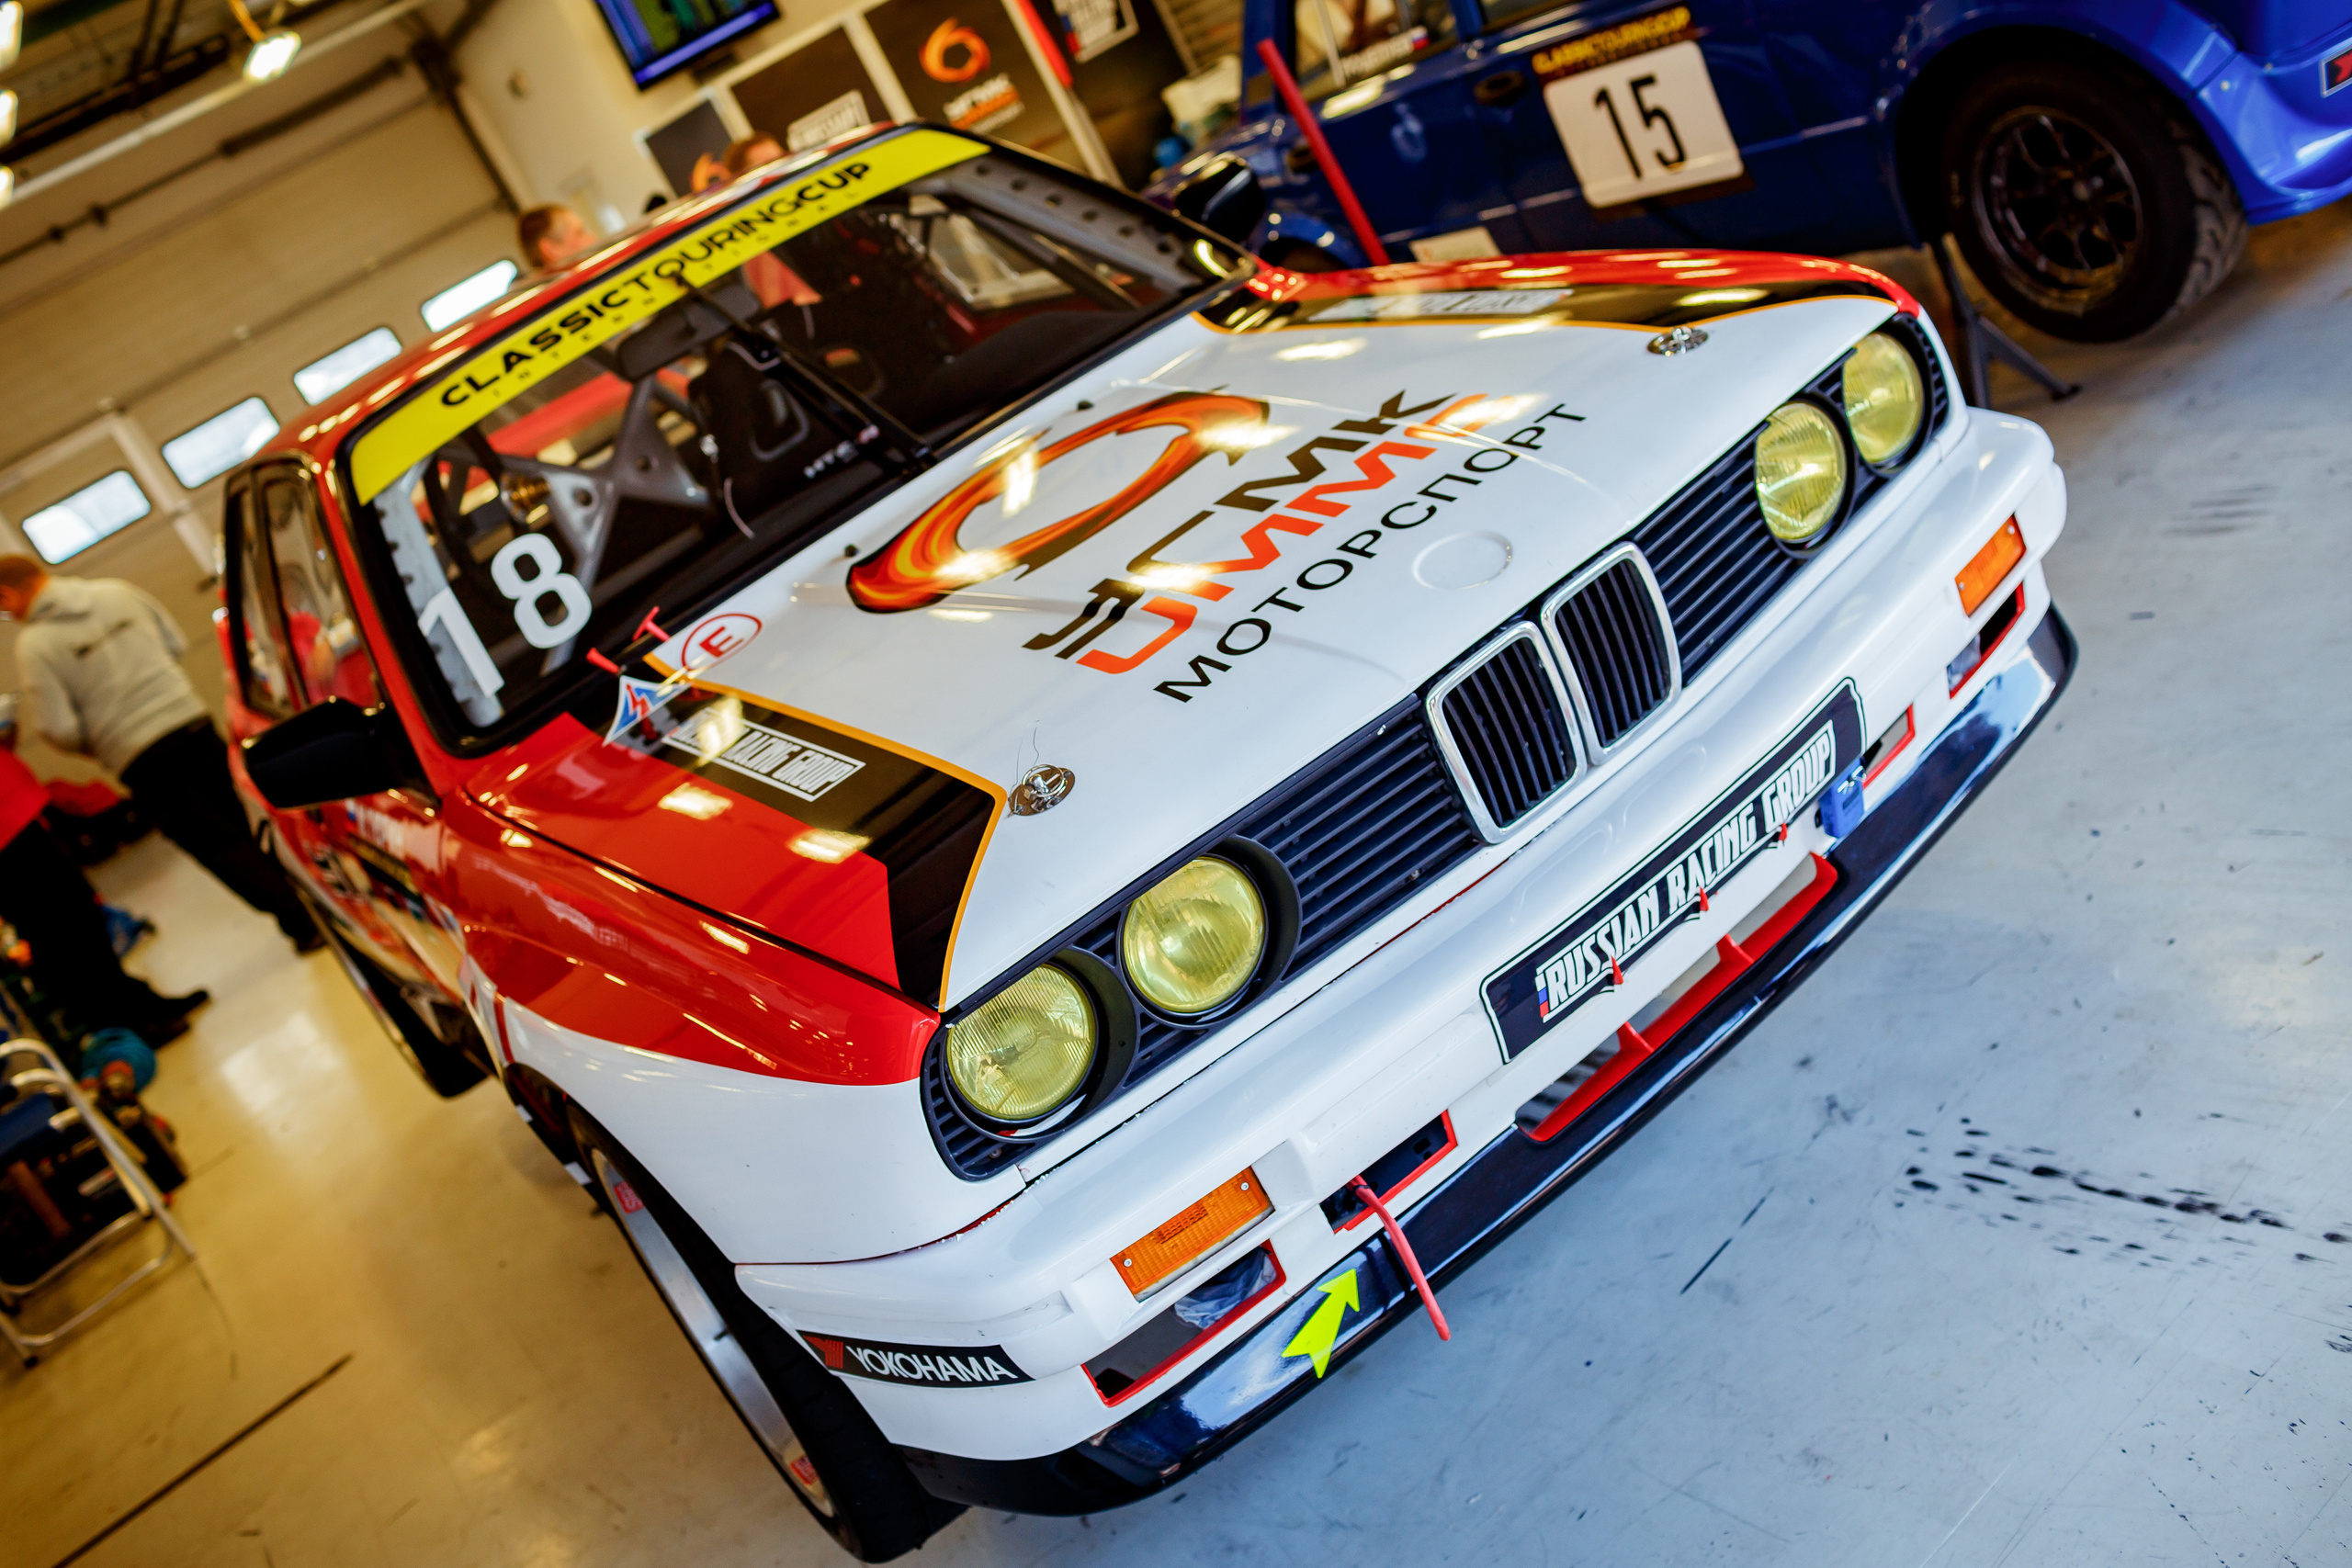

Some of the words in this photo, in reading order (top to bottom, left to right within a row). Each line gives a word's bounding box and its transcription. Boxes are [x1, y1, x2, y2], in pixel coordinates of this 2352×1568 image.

[1593, 73, 1686, 179] 15
[491, 188, 857, 399] INTERNTIONAL
[417, 532, 593, 699] 18
[1152, 403, 1587, 704] МОТОРСПОРТ
[699, 626, 745, 659] E
[721, 729, 802, 774] RACING
[772, 749, 855, 794] GROUP
[1544, 885, 1659, 1010] RUSSIAN
[1667, 802, 1758, 916] RACING
[1760, 732, 1831, 834] GROUP
[845, 1345, 1019, 1382] YOKOHAMA
